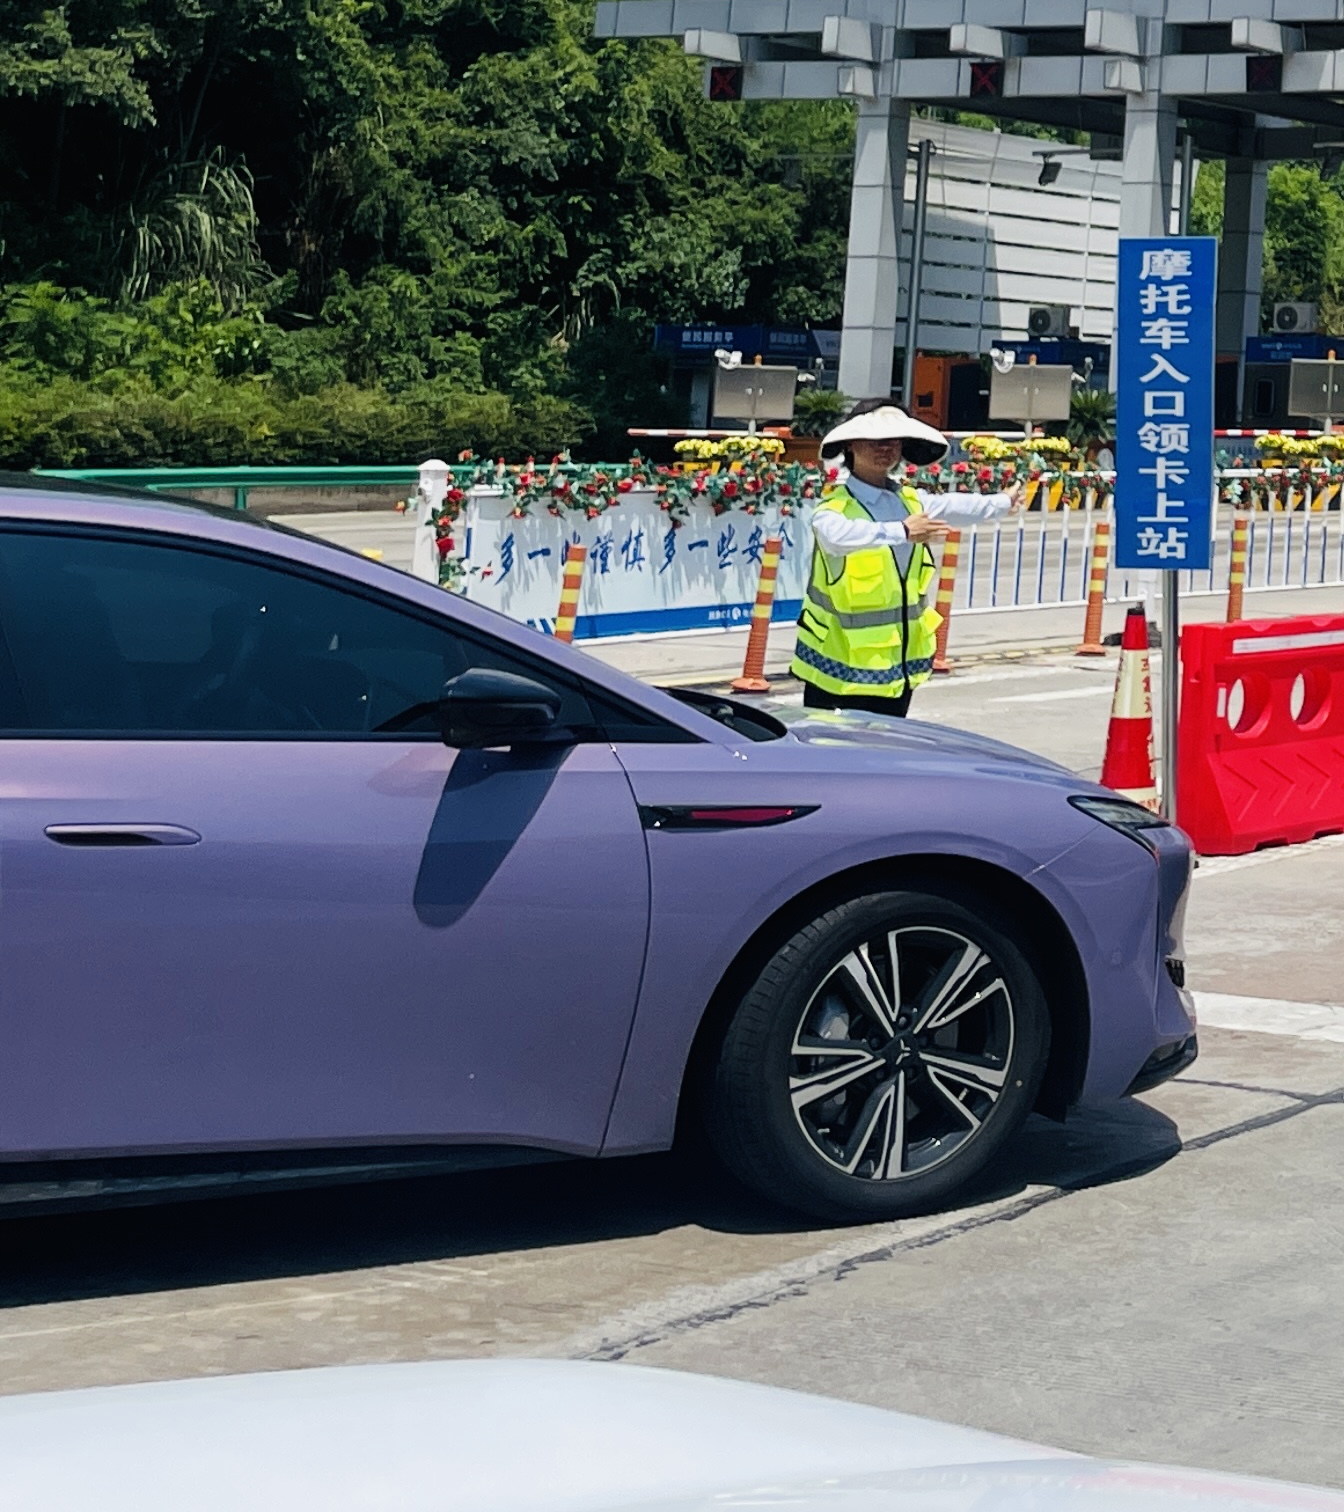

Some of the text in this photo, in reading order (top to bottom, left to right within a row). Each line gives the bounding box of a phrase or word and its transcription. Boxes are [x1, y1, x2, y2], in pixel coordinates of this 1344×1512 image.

[1136, 248, 1192, 559] 摩托车入口领卡上站
